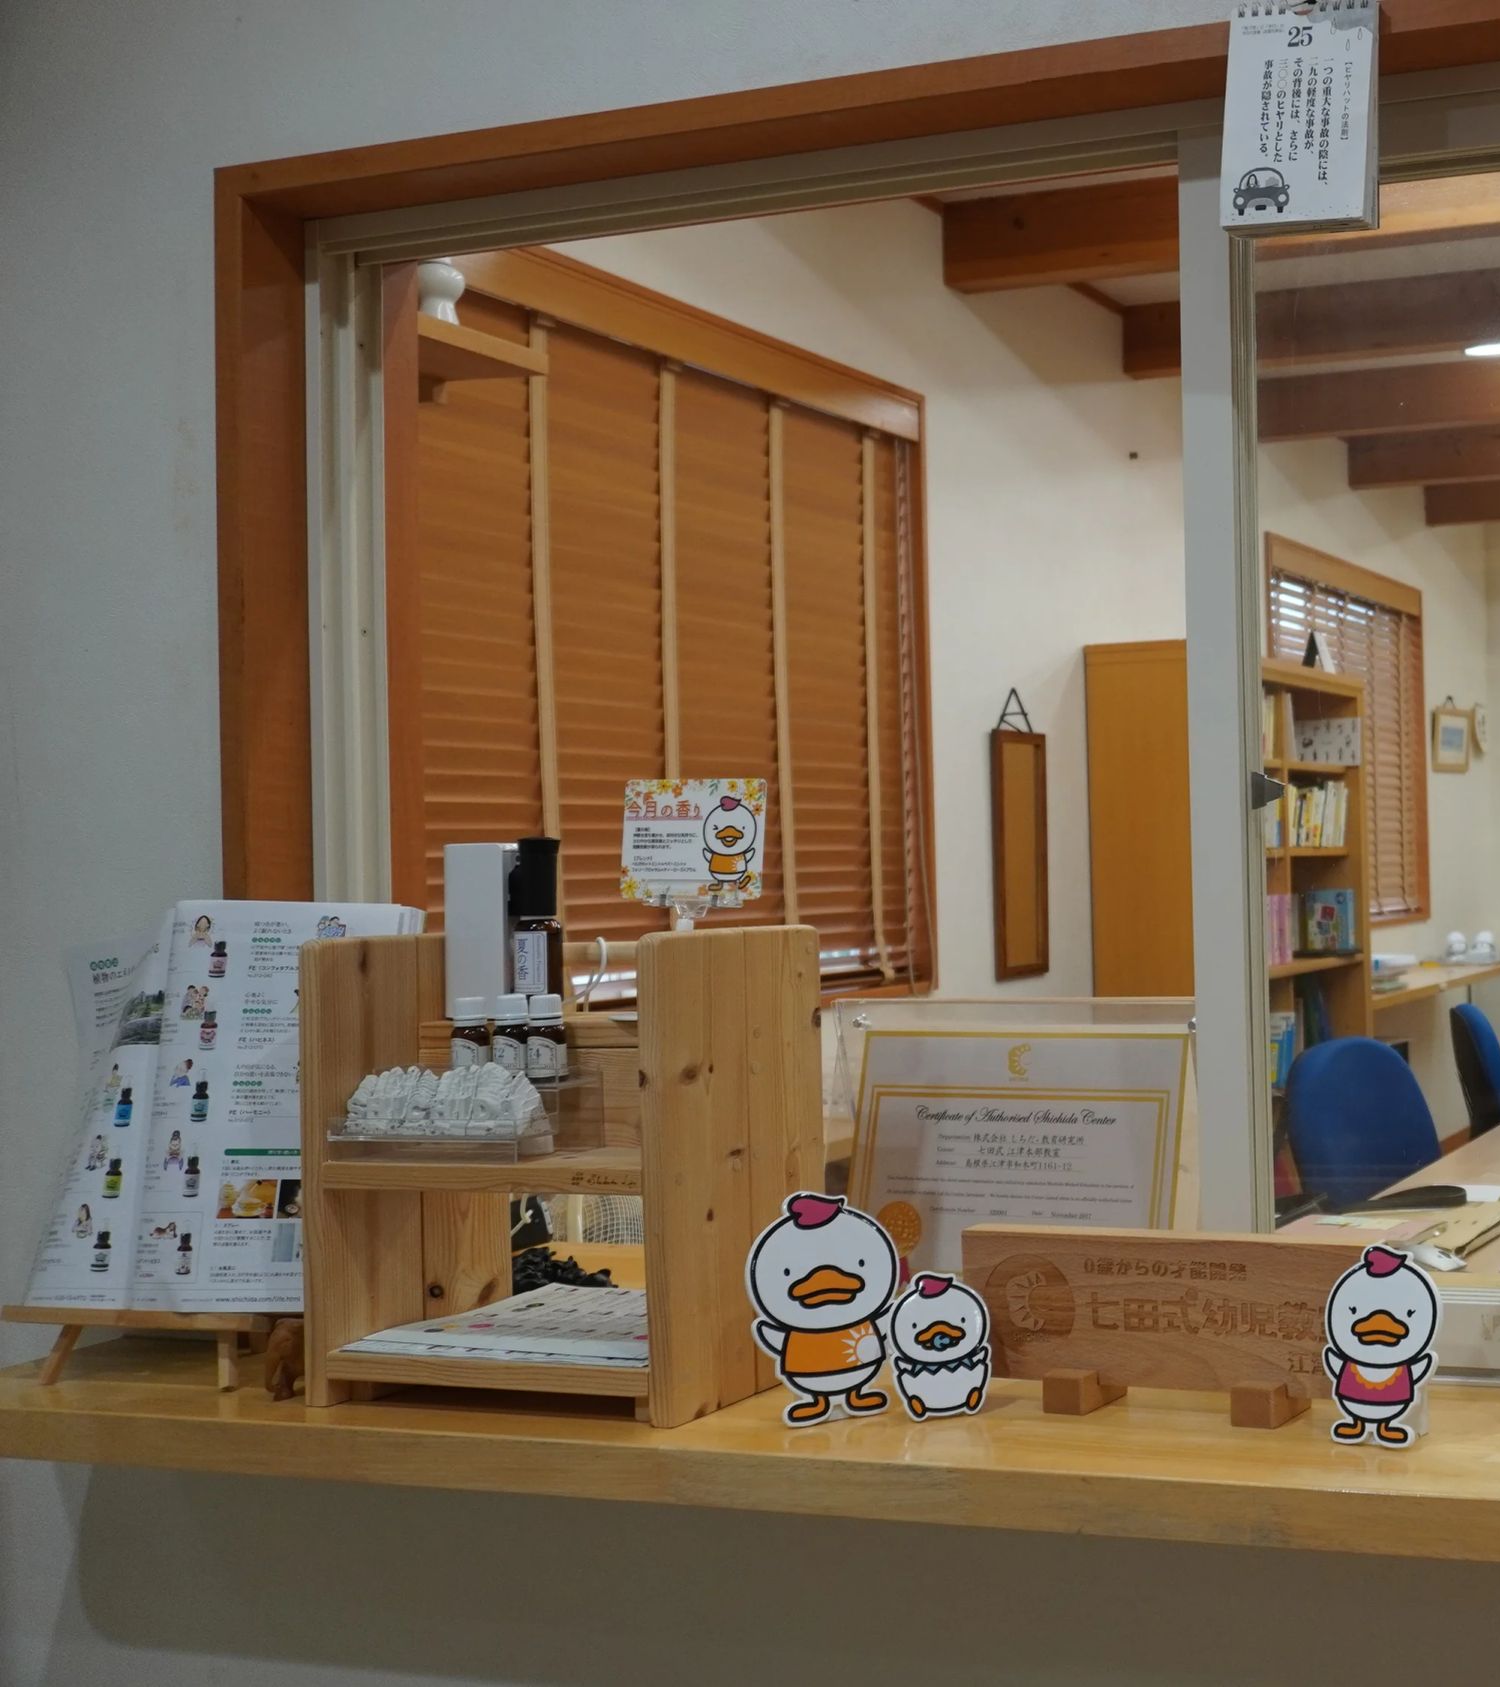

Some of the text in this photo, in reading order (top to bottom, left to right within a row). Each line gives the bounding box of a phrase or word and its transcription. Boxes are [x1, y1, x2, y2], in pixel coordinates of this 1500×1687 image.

[1287, 26, 1313, 47] 25
[1259, 59, 1274, 157] 事故が隠されている。
[1304, 56, 1319, 155] 二九の軽度な事故が、
[1317, 57, 1334, 186] 一つの重大な事故の陰には、
[627, 800, 702, 818] 今月の香り
[915, 1105, 1118, 1126] Certificate of Authorised Shichida Center
[1083, 1258, 1247, 1281] 0歳からの才能開発
